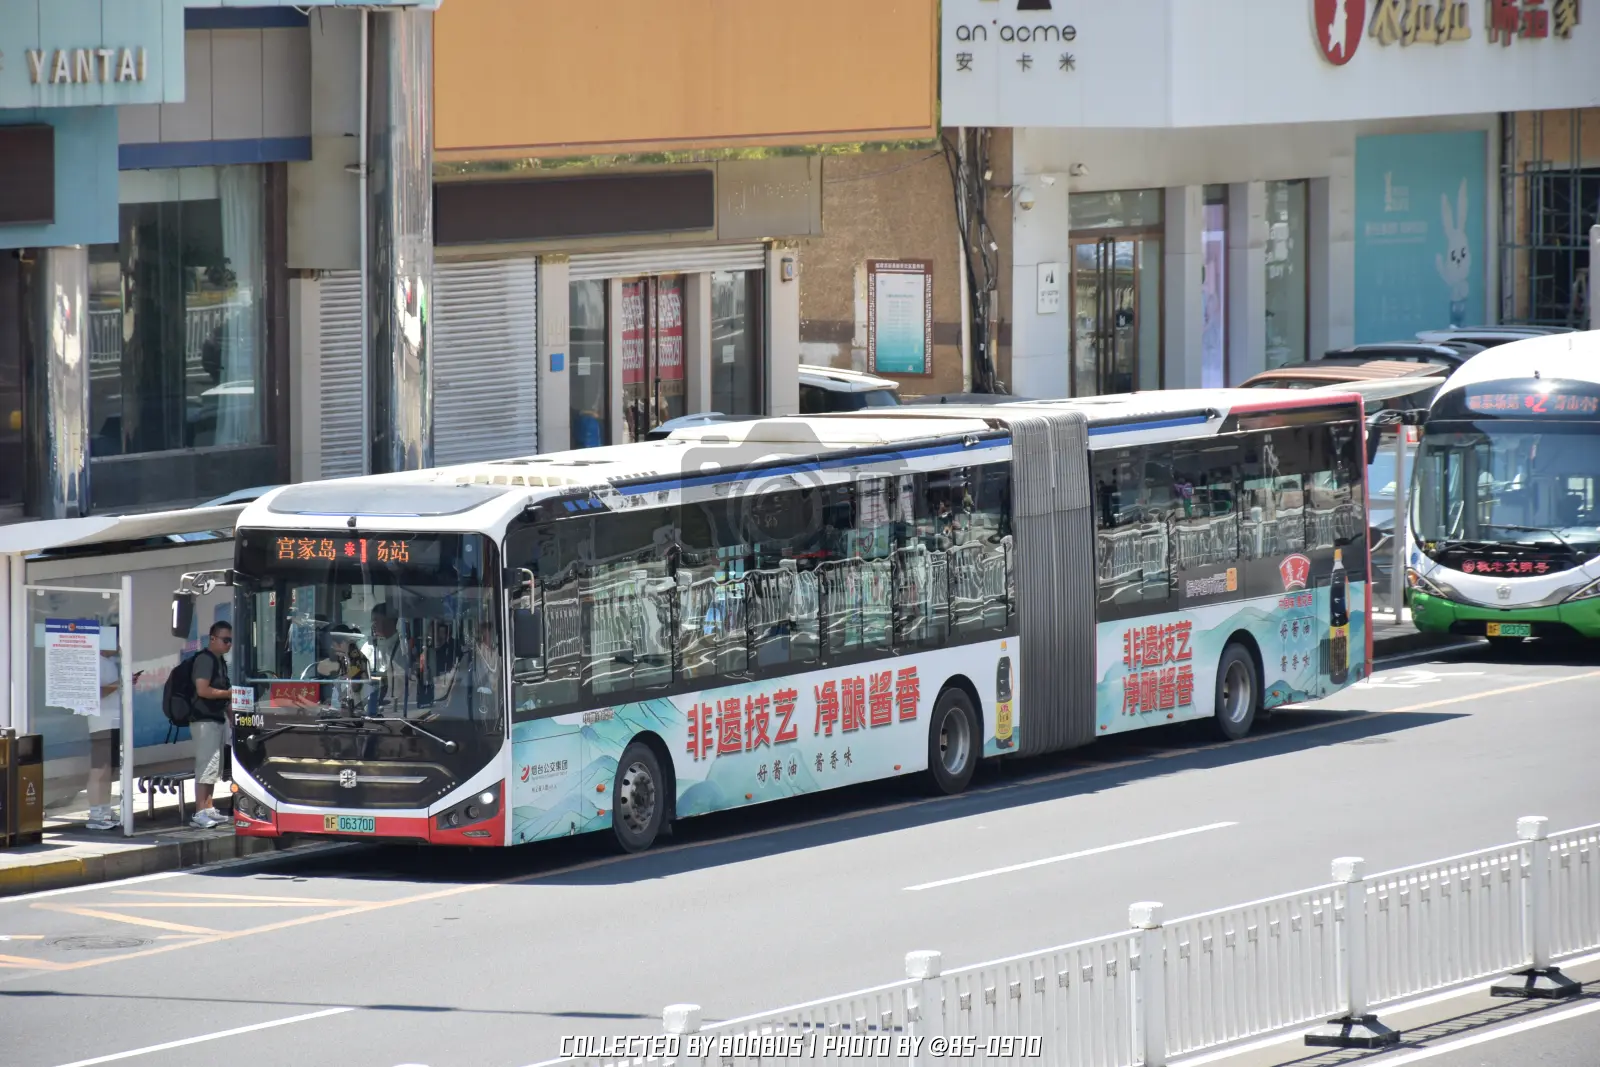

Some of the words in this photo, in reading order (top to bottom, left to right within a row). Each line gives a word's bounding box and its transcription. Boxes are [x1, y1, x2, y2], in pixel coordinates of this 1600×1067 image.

[25, 46, 148, 85] YANTAI
[956, 51, 1076, 73] 安卡米
[276, 536, 337, 561] 宫家岛
[1123, 619, 1193, 671] 非遗技艺
[1122, 664, 1195, 717] 净酿酱香
[686, 687, 799, 763] 非遗技艺
[813, 665, 921, 737] 净酿酱香
[531, 759, 568, 776] 烟台公交集团
[756, 757, 798, 783] 好酱油
[814, 746, 853, 773] 酱香味
